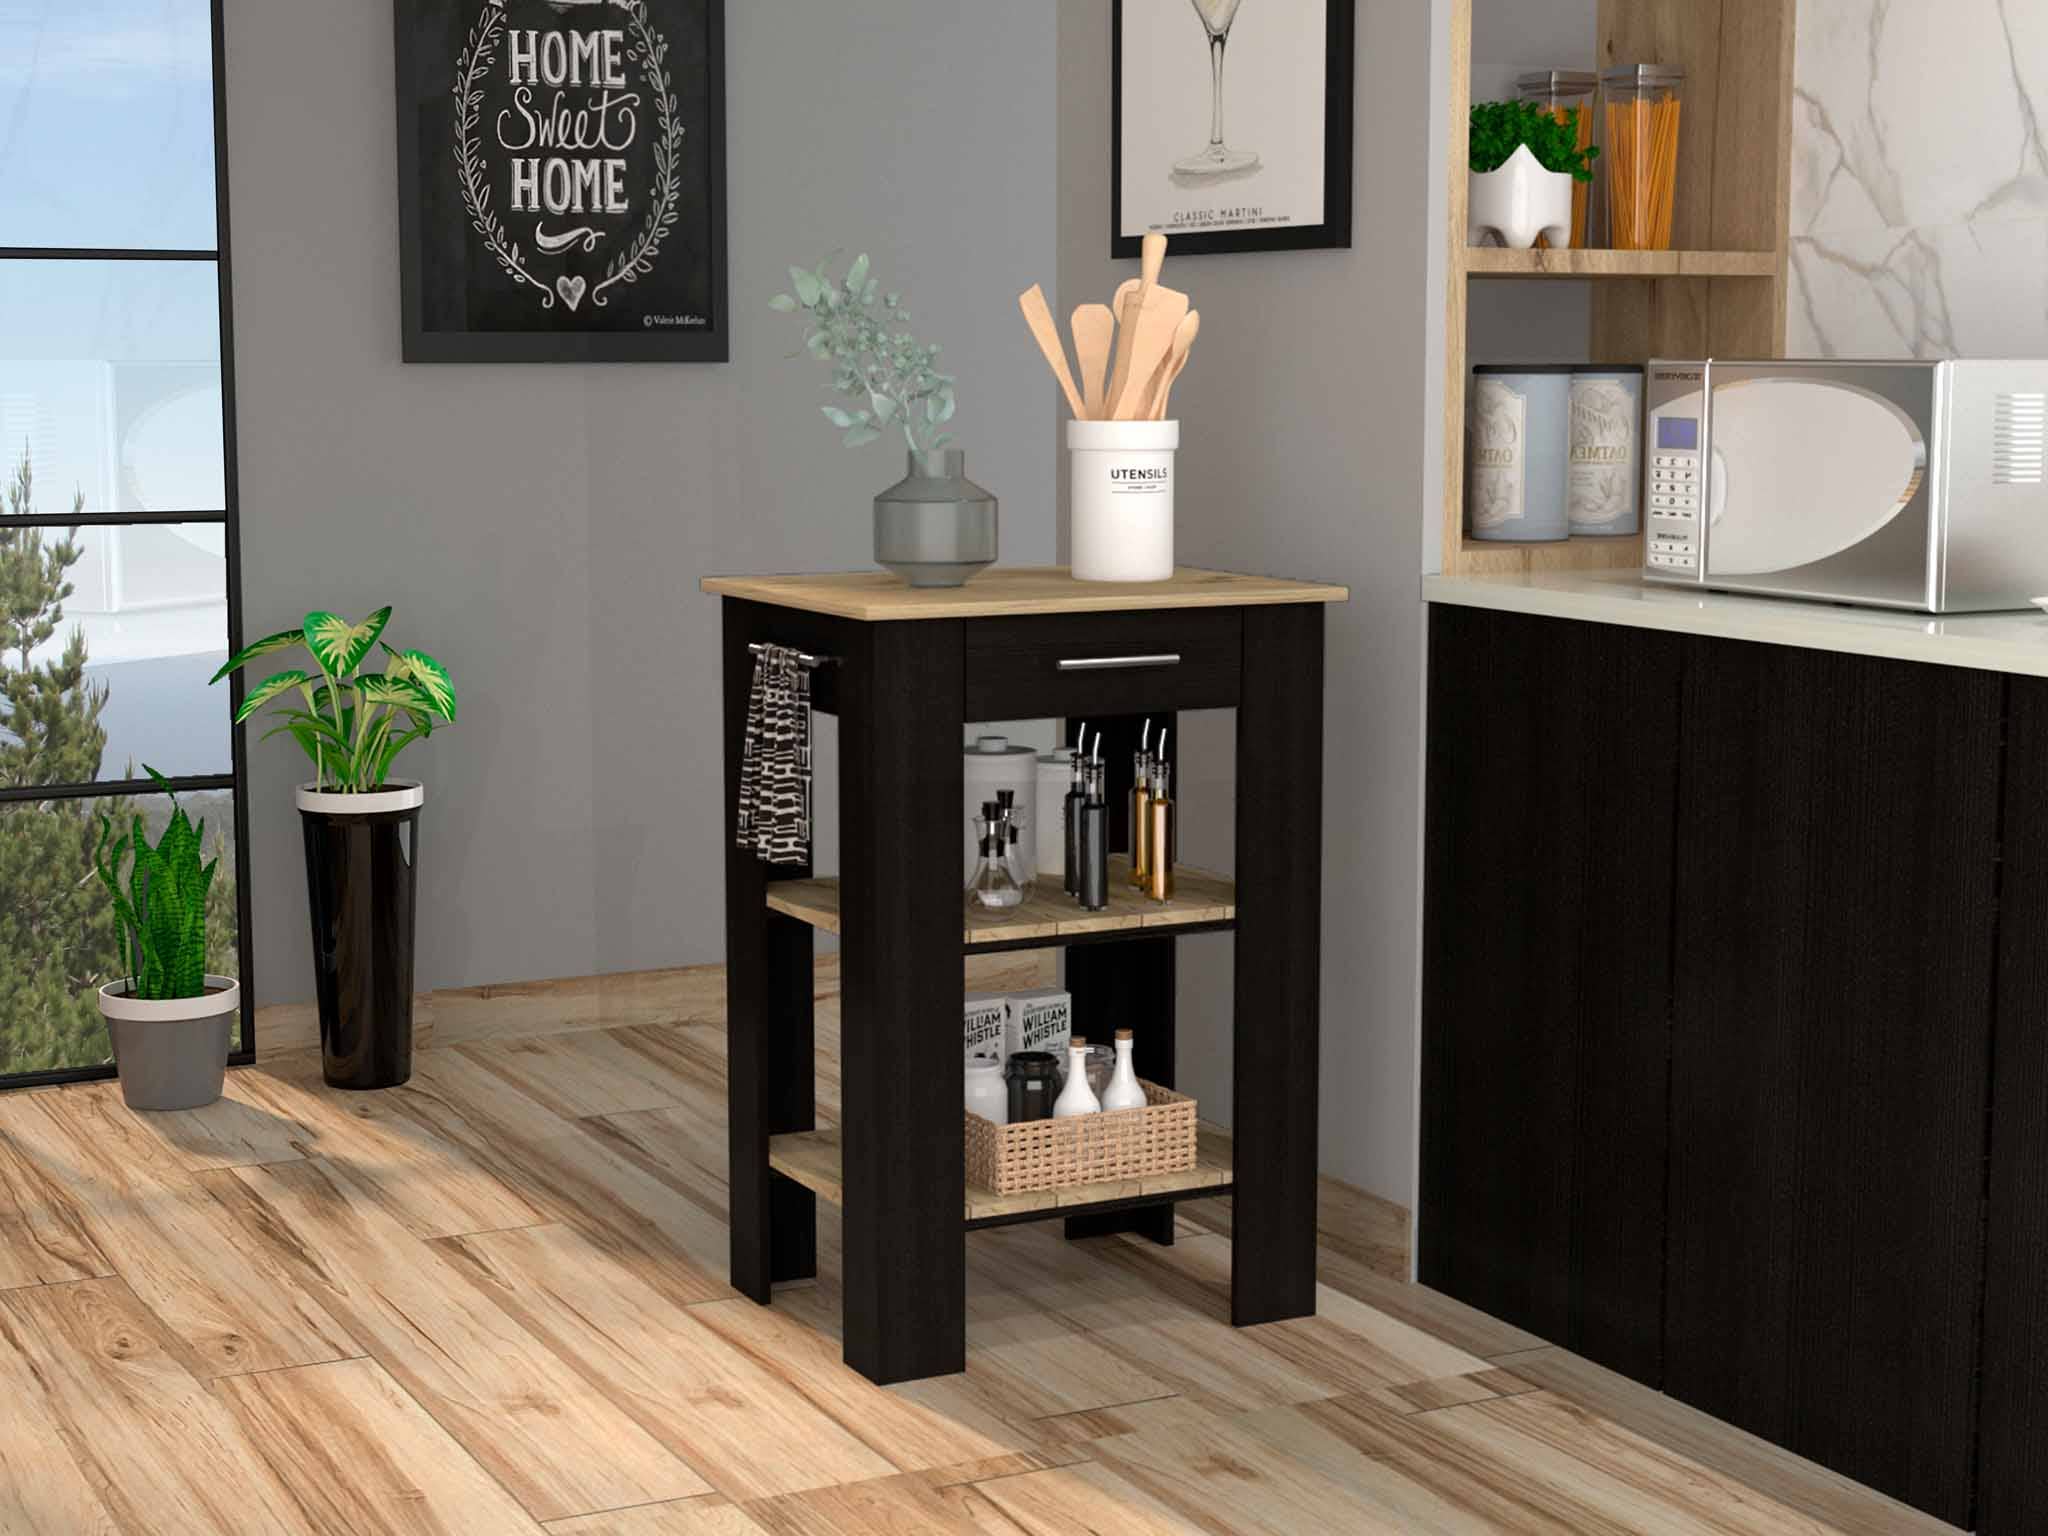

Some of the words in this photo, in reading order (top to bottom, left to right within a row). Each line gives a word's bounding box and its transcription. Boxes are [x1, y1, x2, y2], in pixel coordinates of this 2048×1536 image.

[508, 30, 626, 88] HOME
[496, 86, 640, 150] Sweet
[510, 158, 629, 214] HOME
[1173, 209, 1214, 223] CLASSIC
[1220, 207, 1263, 218] MARTINI
[1110, 467, 1168, 480] UTENSILS
[964, 1012, 1001, 1033] ILLIAM
[1022, 1007, 1067, 1033] WILLIAM
[965, 1024, 1001, 1049] HISTLE
[1022, 1020, 1067, 1050] WHISTLE
